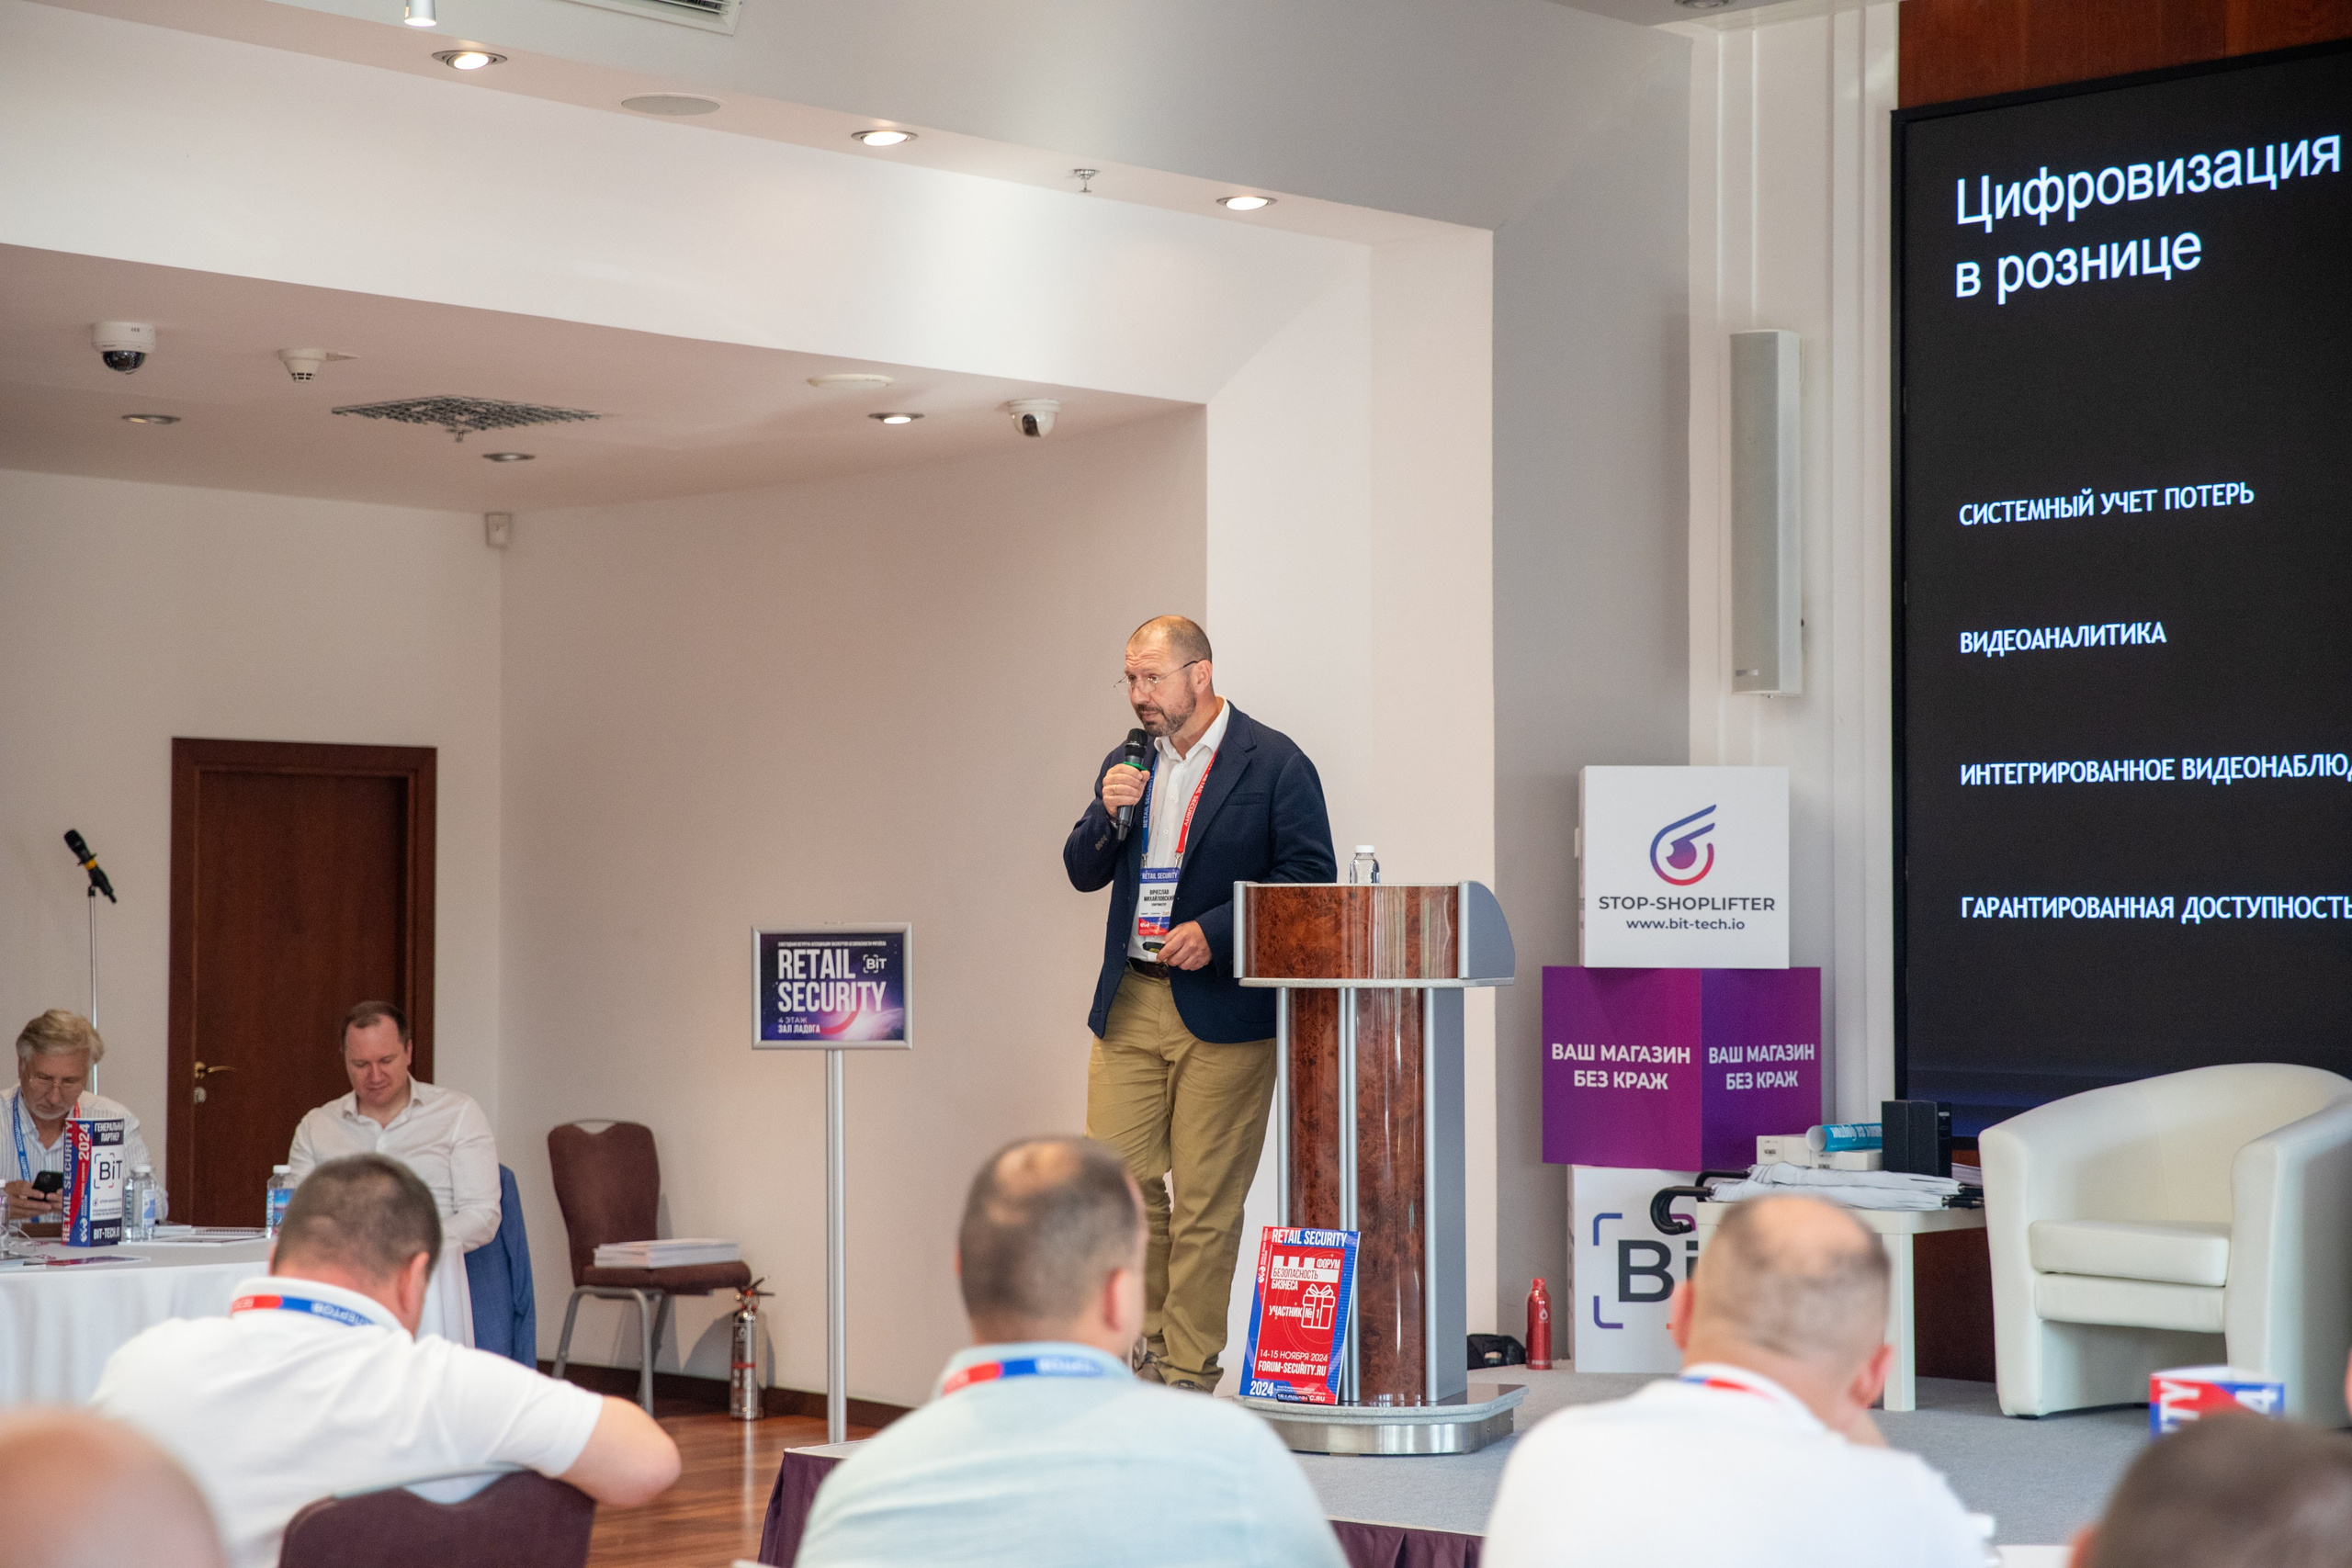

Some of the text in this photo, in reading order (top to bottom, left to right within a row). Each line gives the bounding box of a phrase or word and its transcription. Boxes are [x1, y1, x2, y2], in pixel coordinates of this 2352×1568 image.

[1956, 134, 2341, 234] Цифровизация
[1955, 231, 2202, 305] в рознице
[1959, 481, 2255, 526] СИСТЕМНЫЙ УЧЕТ ПОТЕРЬ
[1960, 621, 2167, 659] ВИДЕОАНАЛИТИКА
[1960, 758, 2176, 786] ИНТЕГРИРОВАННОЕ
[1599, 896, 1775, 911] STOP-SHOPLIFTER
[1961, 896, 2175, 919] ГАРАНТИРОВАННАЯ
[1626, 917, 1745, 930] www.bit-tech.io
[777, 949, 856, 979] RETAIL
[777, 981, 887, 1012] SECURITY
[777, 1024, 820, 1034] ЗАЛ ЛАДОГА
[785, 1016, 808, 1024] ЭТАЖ
[1552, 1043, 1690, 1064] ВАШ МАГАЗИН
[1709, 1043, 1815, 1064] ВАШ МАГАЗИН
[1574, 1070, 1668, 1089] БЕЗ КРАЖ
[1725, 1070, 1799, 1090] БЕЗ КРАЖ
[78, 1122, 91, 1160] 2024
[62, 1121, 74, 1241] RETAIL SECURITY
[1272, 1228, 1348, 1247] RETAIL SECURITY
[1316, 1258, 1340, 1269] ФОРУМ
[1618, 1239, 1698, 1303] Bi
[1272, 1268, 1318, 1280] БЕЗОПАСНОСТЬ
[1271, 1279, 1298, 1291] БИЗНЕСА
[1269, 1305, 1303, 1317] УЧАСТНИК
[1260, 1348, 1329, 1362] 14-15 НОЯБРЯ 2024
[1258, 1360, 1327, 1376] FORUM-SECURITY.RU
[1250, 1380, 1274, 1396] 2024
